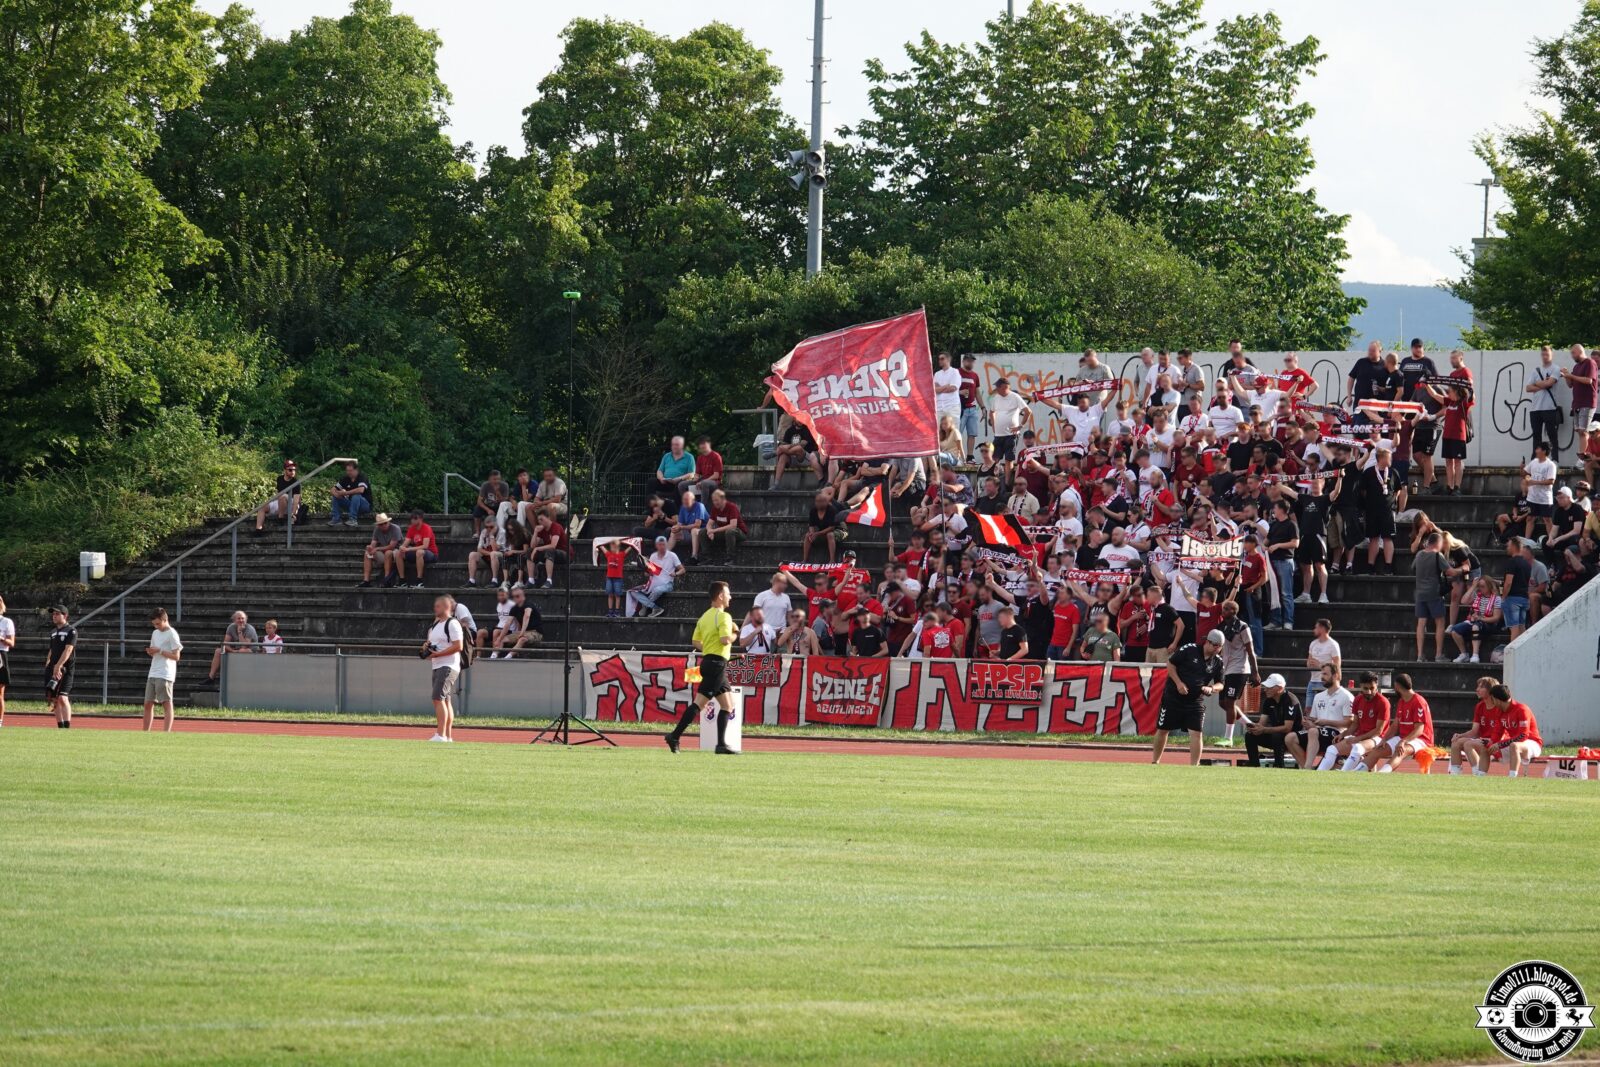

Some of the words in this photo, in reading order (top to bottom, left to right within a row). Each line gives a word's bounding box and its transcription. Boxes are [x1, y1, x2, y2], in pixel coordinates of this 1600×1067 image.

[812, 672, 868, 702] SZENE
[868, 673, 882, 706] E
[973, 663, 1043, 691] TPSP
[816, 703, 874, 715] REUTLINGEN
